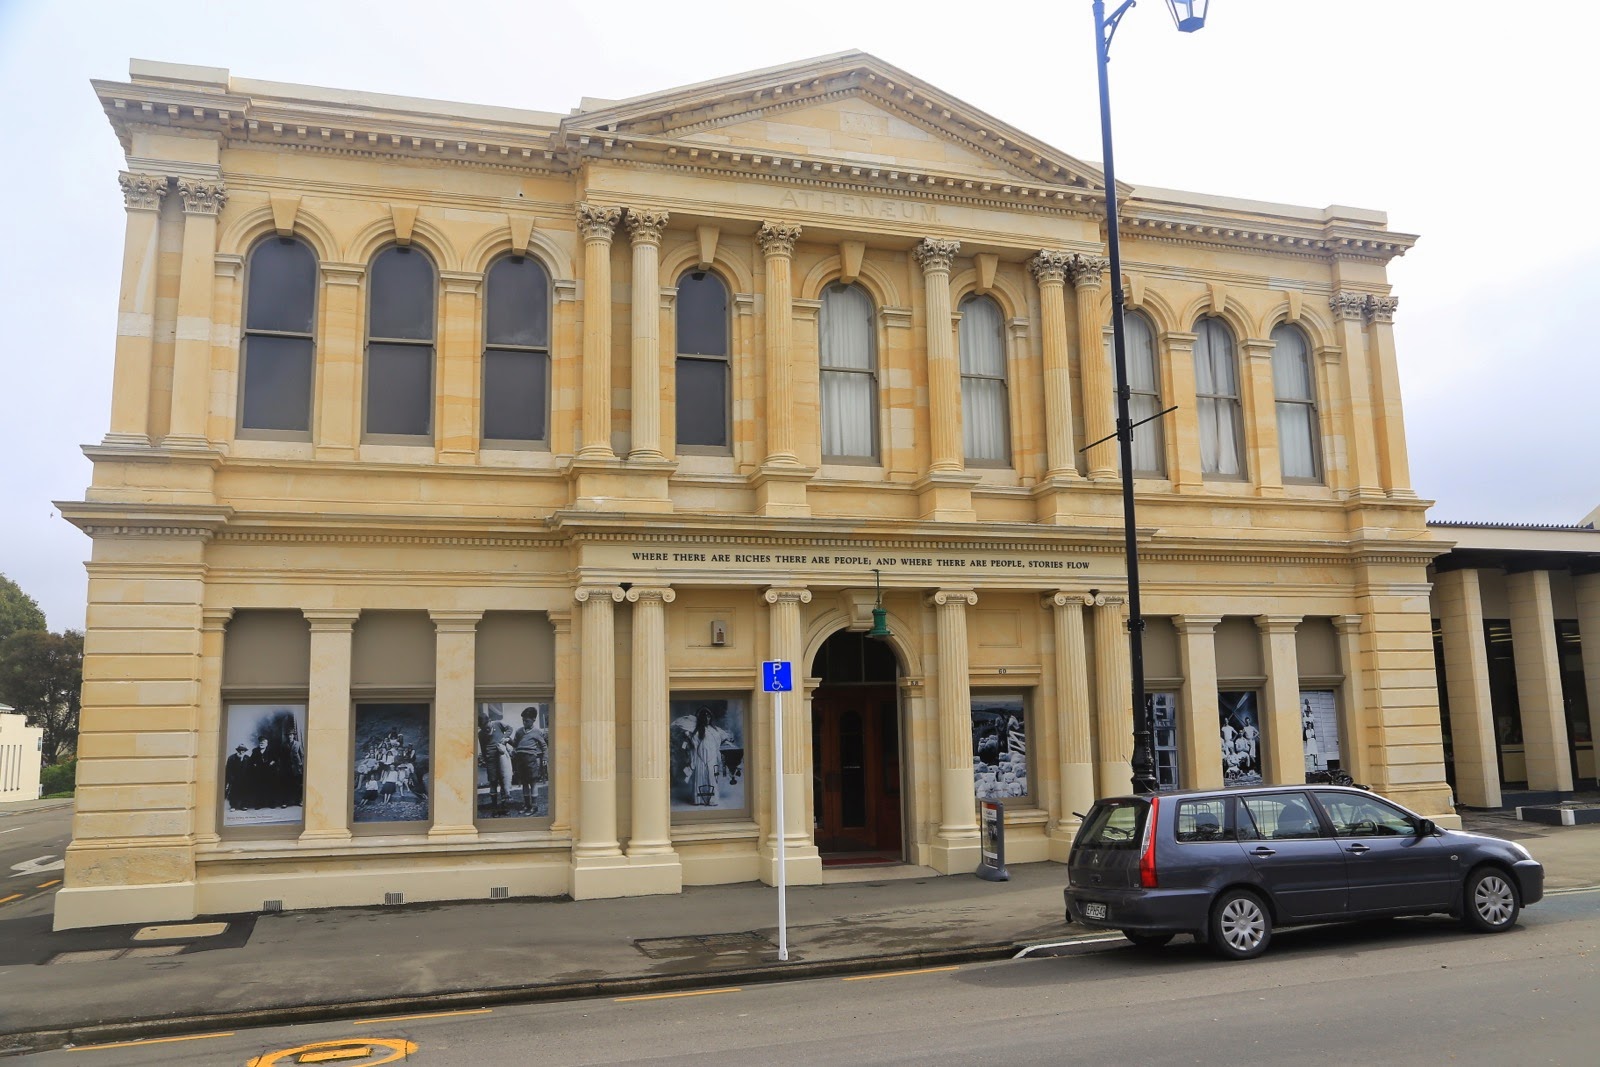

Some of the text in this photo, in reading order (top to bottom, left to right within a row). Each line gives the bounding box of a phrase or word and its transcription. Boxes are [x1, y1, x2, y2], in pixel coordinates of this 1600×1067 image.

[631, 552, 669, 561] WHERE
[673, 553, 706, 562] THERE
[710, 554, 731, 563] ARE
[735, 554, 771, 563] RICHES
[775, 555, 807, 564] THERE
[811, 555, 830, 564] ARE
[876, 557, 897, 566] AND
[901, 558, 933, 567] WHERE
[936, 559, 966, 567] THERE
[969, 559, 988, 568] ARE
[991, 559, 1025, 569] PEOPLE,
[1028, 560, 1063, 569] STORIES
[1067, 561, 1090, 570] FLOW
[772, 663, 782, 675] P
